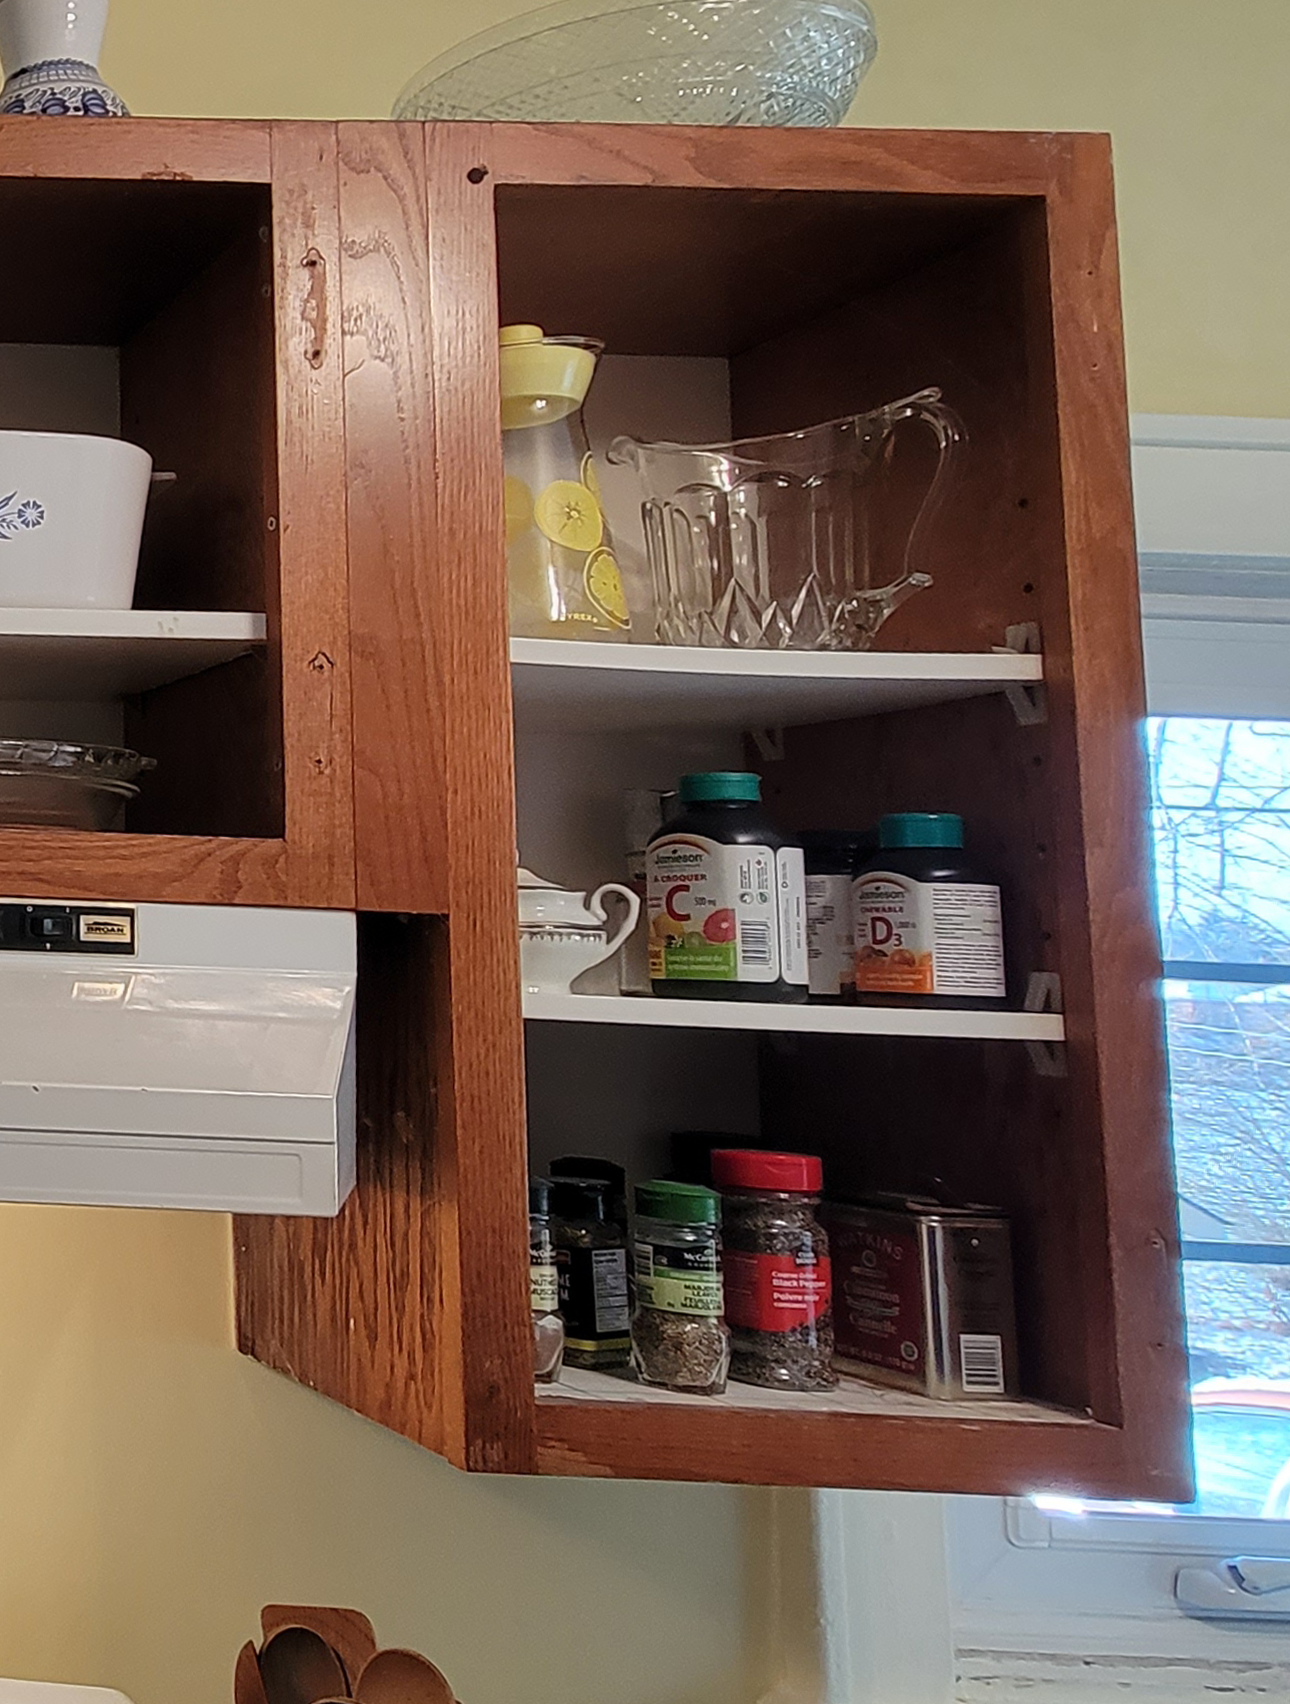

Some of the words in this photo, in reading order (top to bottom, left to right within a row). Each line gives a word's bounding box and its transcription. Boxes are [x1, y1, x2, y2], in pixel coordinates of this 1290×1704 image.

[655, 852, 704, 864] Jamieson
[665, 884, 692, 922] C
[86, 926, 125, 934] BROAN
[772, 1278, 799, 1287] Black
[773, 1292, 803, 1301] Poivre
